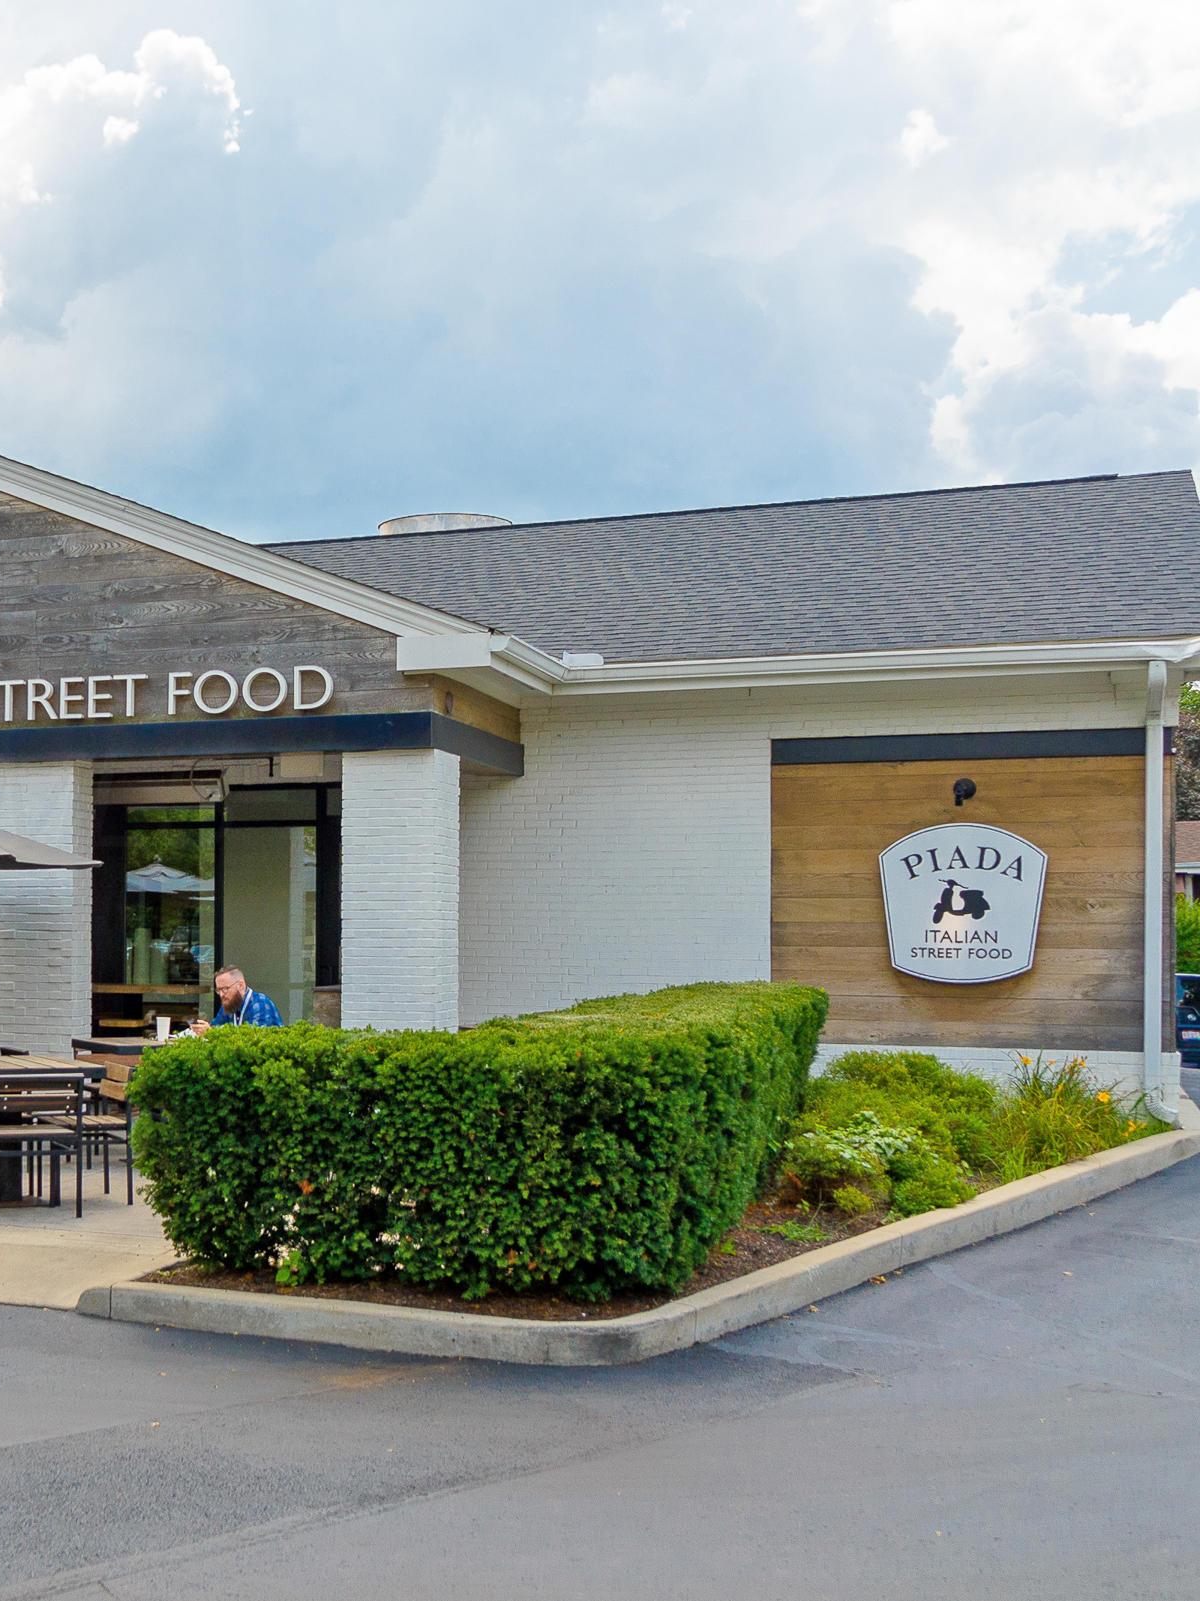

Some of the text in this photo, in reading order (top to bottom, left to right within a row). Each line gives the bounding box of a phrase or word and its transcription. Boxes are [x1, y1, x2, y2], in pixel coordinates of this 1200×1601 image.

[167, 665, 335, 715] FOOD
[900, 845, 1024, 882] PIADA
[924, 929, 998, 944] ITALIAN
[911, 947, 1013, 960] STREET FOOD
